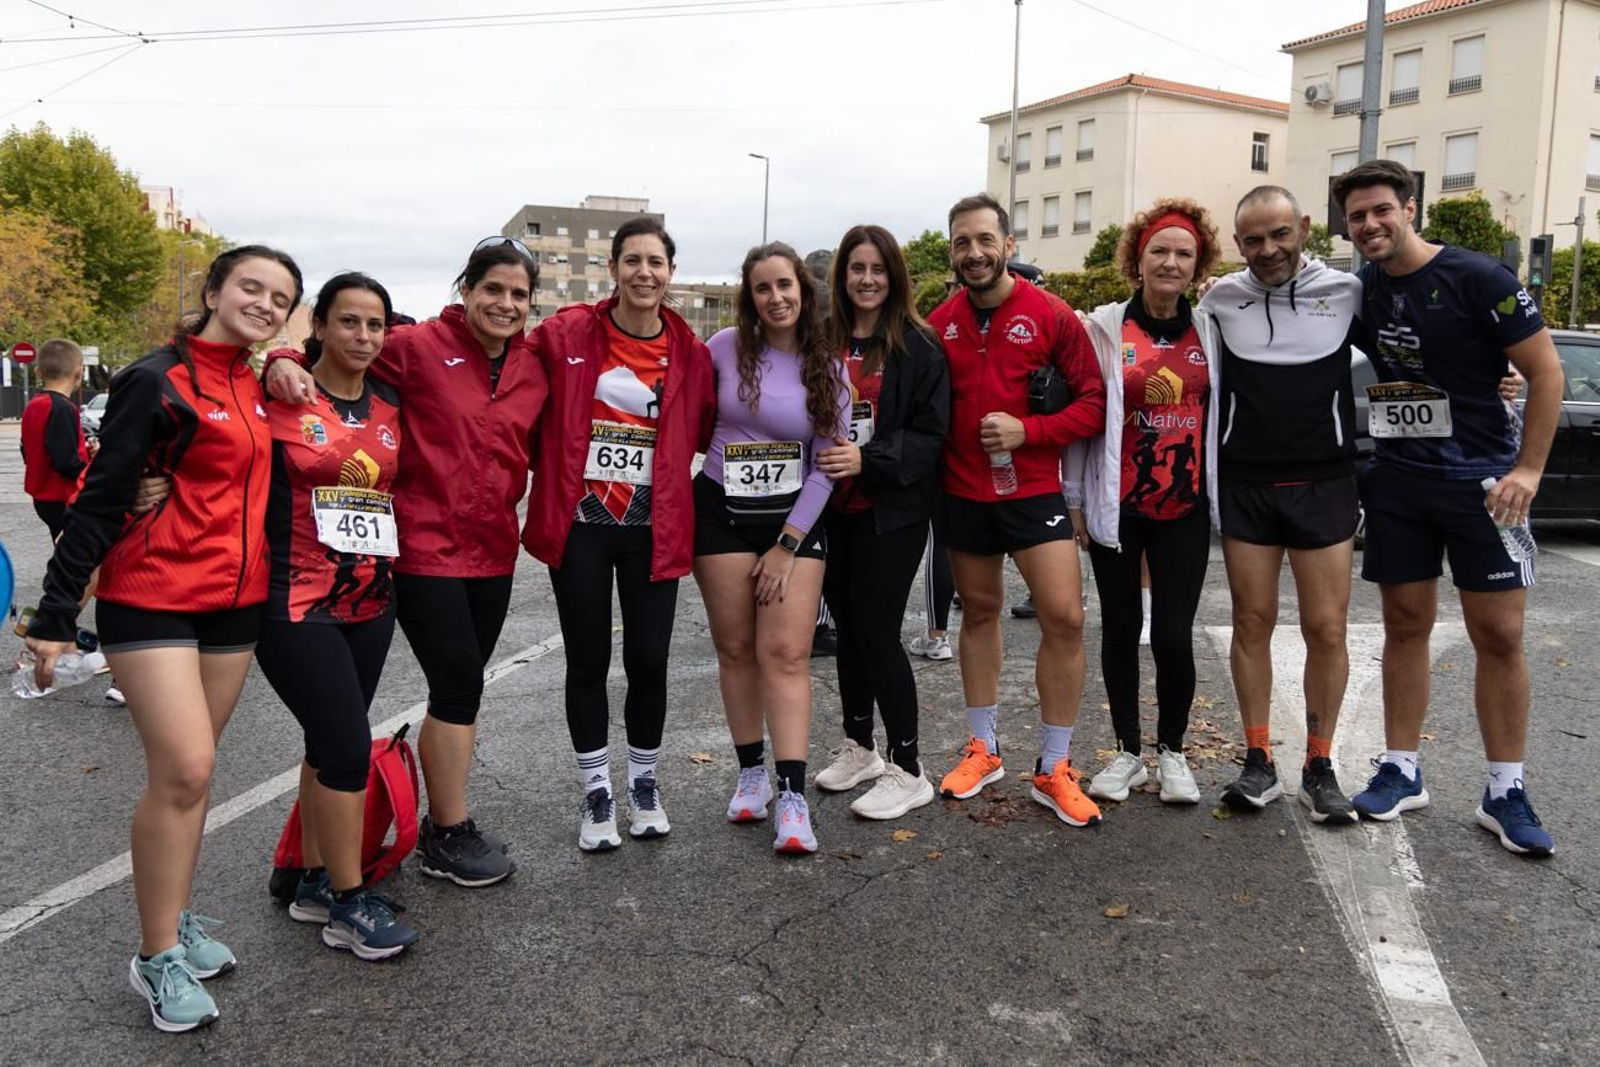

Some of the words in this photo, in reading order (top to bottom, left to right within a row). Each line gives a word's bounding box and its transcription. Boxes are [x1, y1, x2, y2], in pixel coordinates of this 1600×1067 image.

[1387, 404, 1433, 425] 500
[597, 446, 644, 471] 634
[727, 444, 744, 457] XXV
[740, 464, 786, 485] 347
[318, 490, 338, 502] XXV
[336, 513, 380, 540] 461
[1488, 571, 1515, 580] adidas
